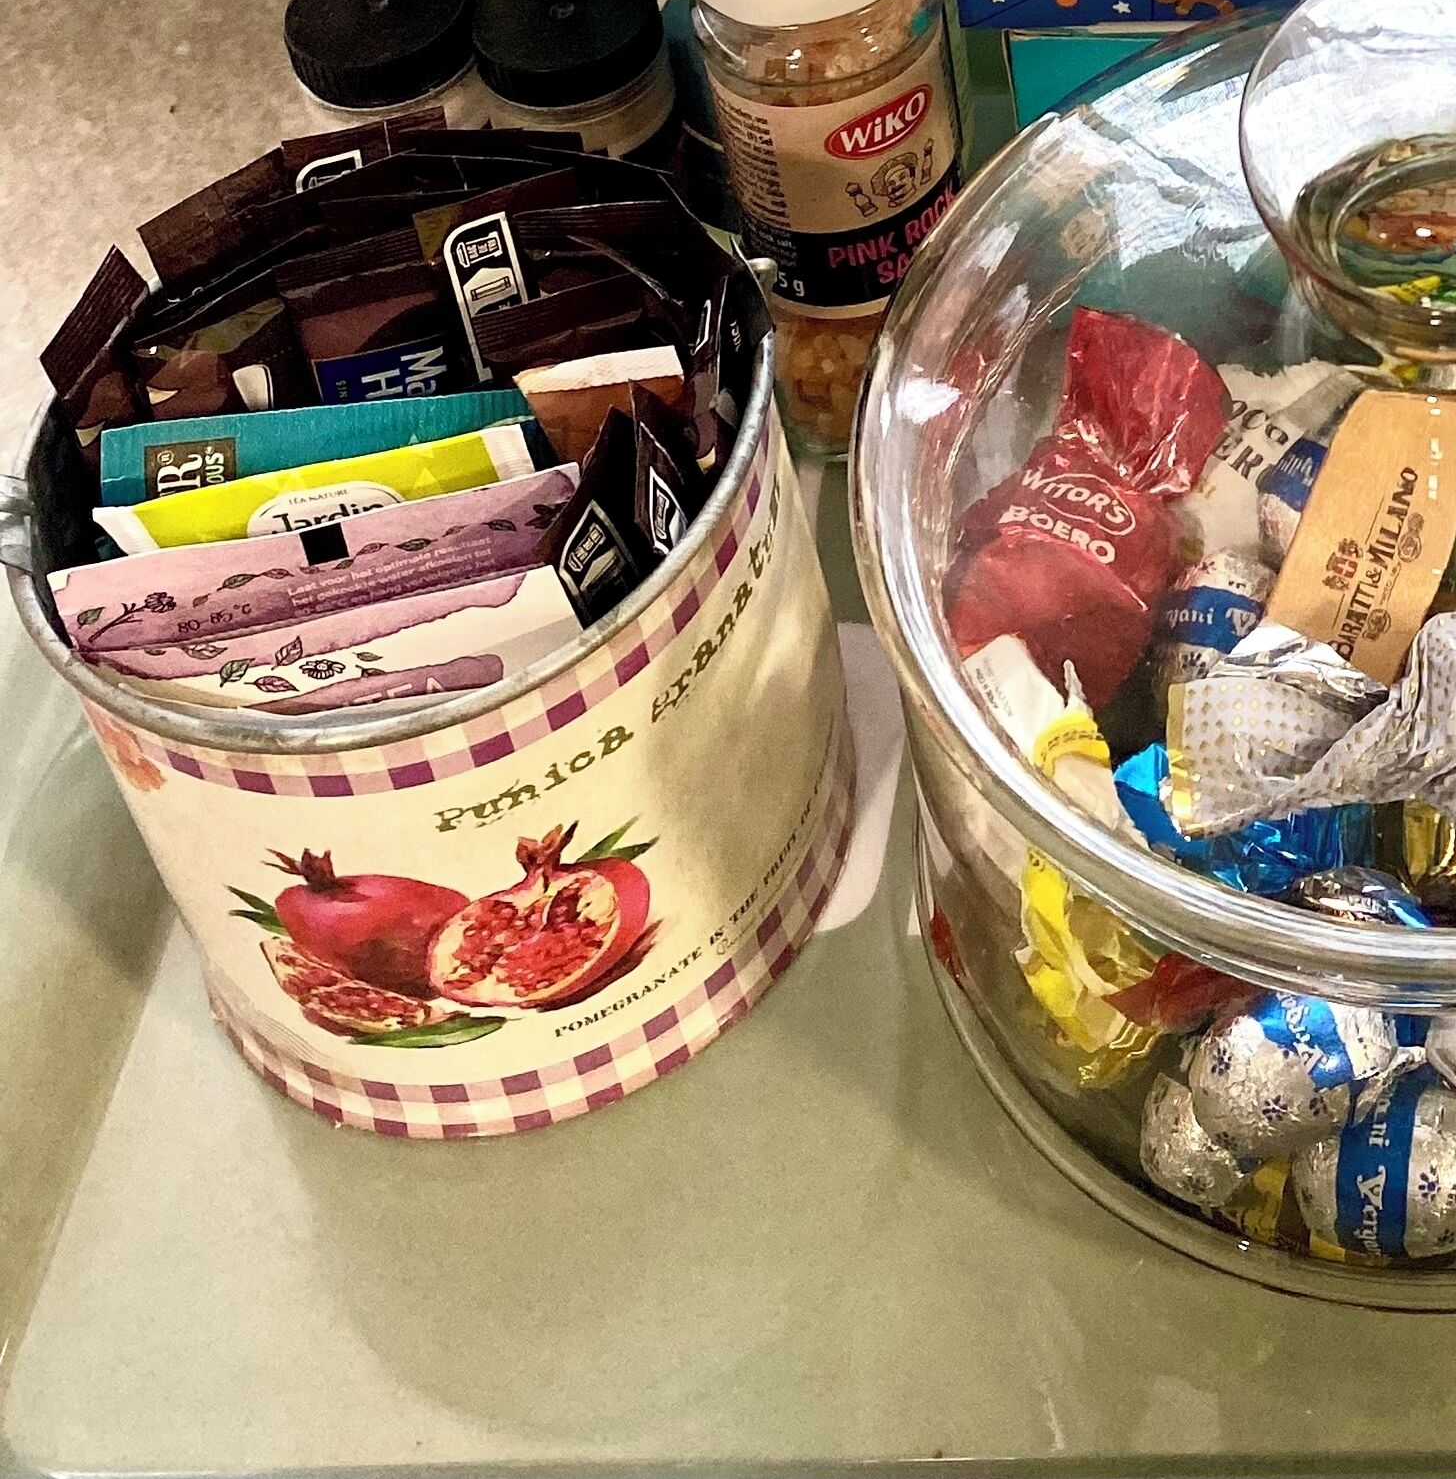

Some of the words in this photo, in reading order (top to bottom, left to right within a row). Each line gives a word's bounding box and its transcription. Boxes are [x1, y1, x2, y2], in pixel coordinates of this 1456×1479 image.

[828, 231, 898, 269] PINK
[877, 253, 911, 284] SA
[1021, 465, 1130, 526] WITOR'S
[1368, 466, 1418, 570] MILANO
[999, 505, 1117, 566] BOERO
[434, 724, 634, 832] Punica
[554, 946, 702, 1038] POMEGRANATE
